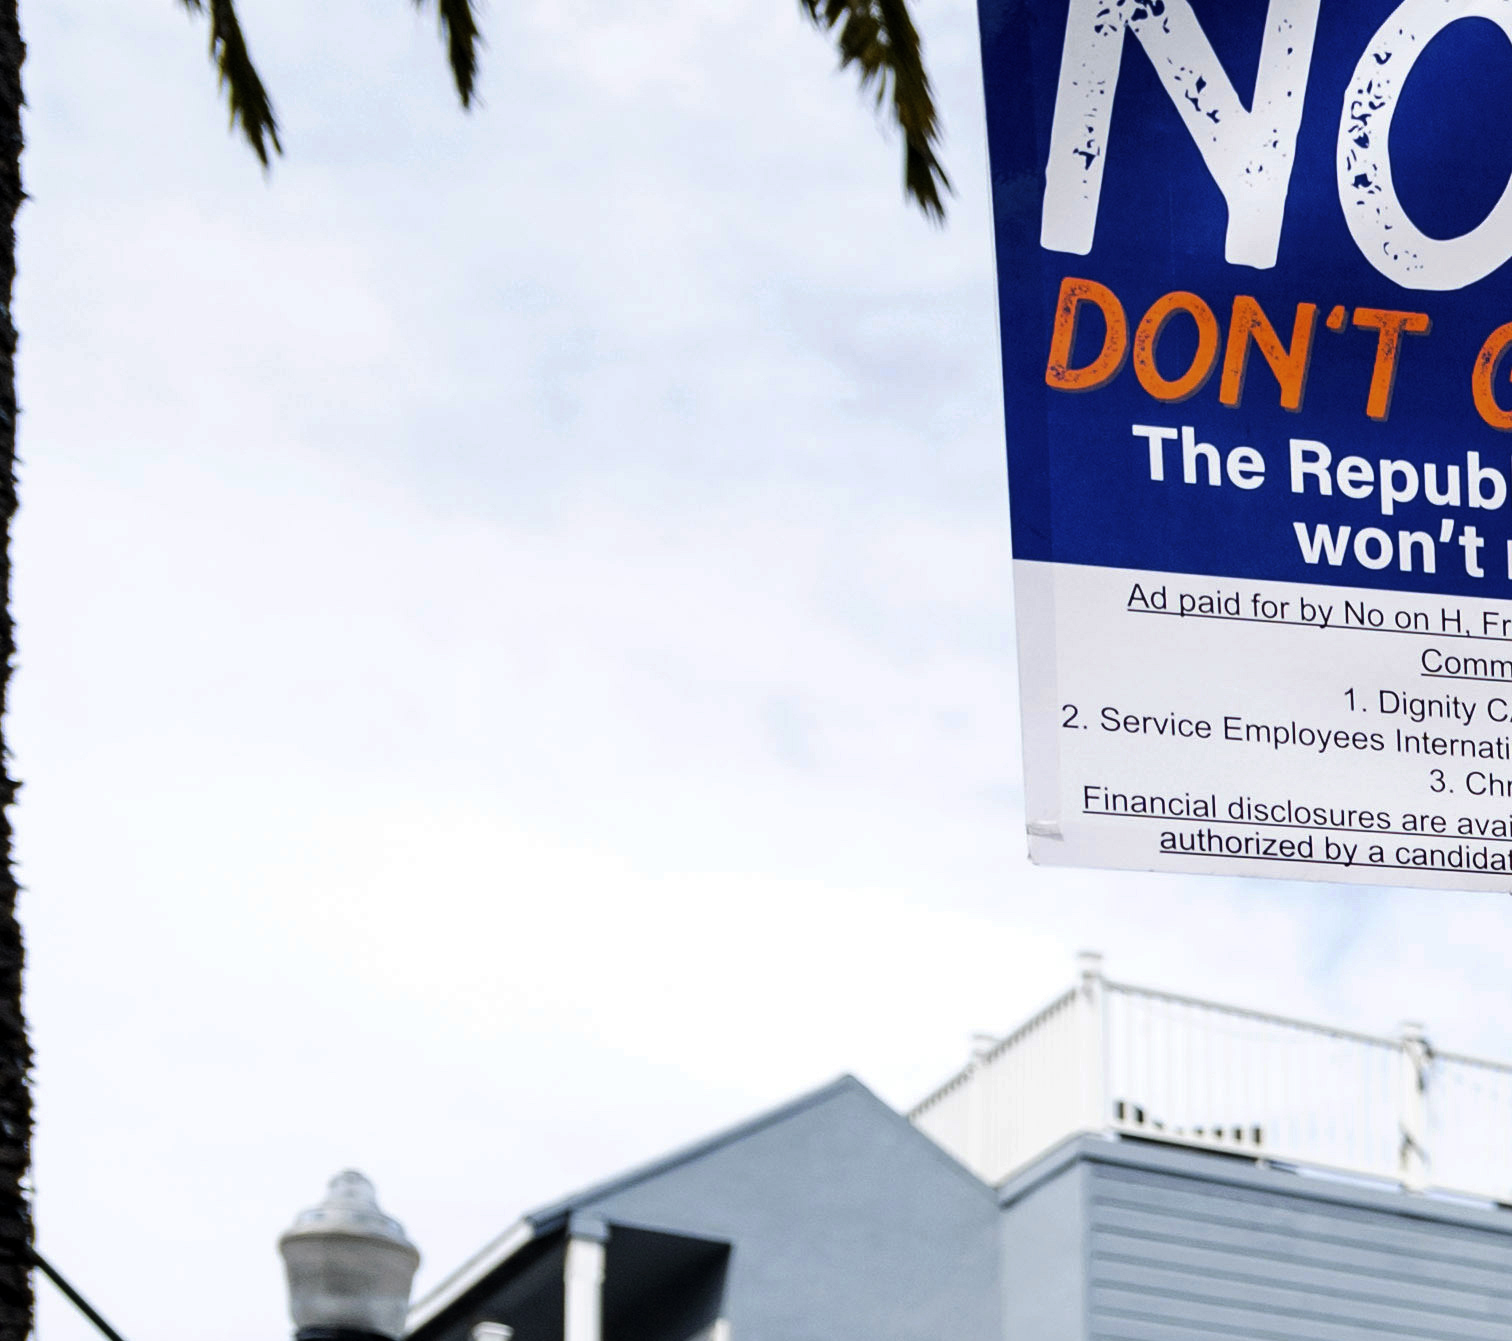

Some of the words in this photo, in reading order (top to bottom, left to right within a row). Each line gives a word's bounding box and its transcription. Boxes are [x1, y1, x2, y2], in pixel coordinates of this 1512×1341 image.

[1045, 276, 1429, 419] DON'T
[1131, 424, 1266, 490] The
[1293, 517, 1485, 578] won't
[1127, 583, 1167, 610] Ad
[1179, 590, 1240, 618] paid
[1251, 592, 1290, 619] for
[1300, 596, 1334, 629] by
[1344, 600, 1384, 628] No
[1394, 610, 1429, 631] on
[1441, 607, 1470, 636] H,
[1062, 704, 1087, 729] 2.
[1101, 706, 1212, 739] Service
[1223, 716, 1385, 754] Employees
[1344, 687, 1367, 713] 1.
[1379, 689, 1477, 726] Dignity
[1430, 768, 1454, 794] 3.
[1084, 785, 1217, 819] Financial
[1228, 796, 1391, 830] disclosures
[1402, 813, 1447, 834] are
[1160, 828, 1313, 859] authorized
[1325, 835, 1358, 868] by
[1368, 845, 1385, 863] a
